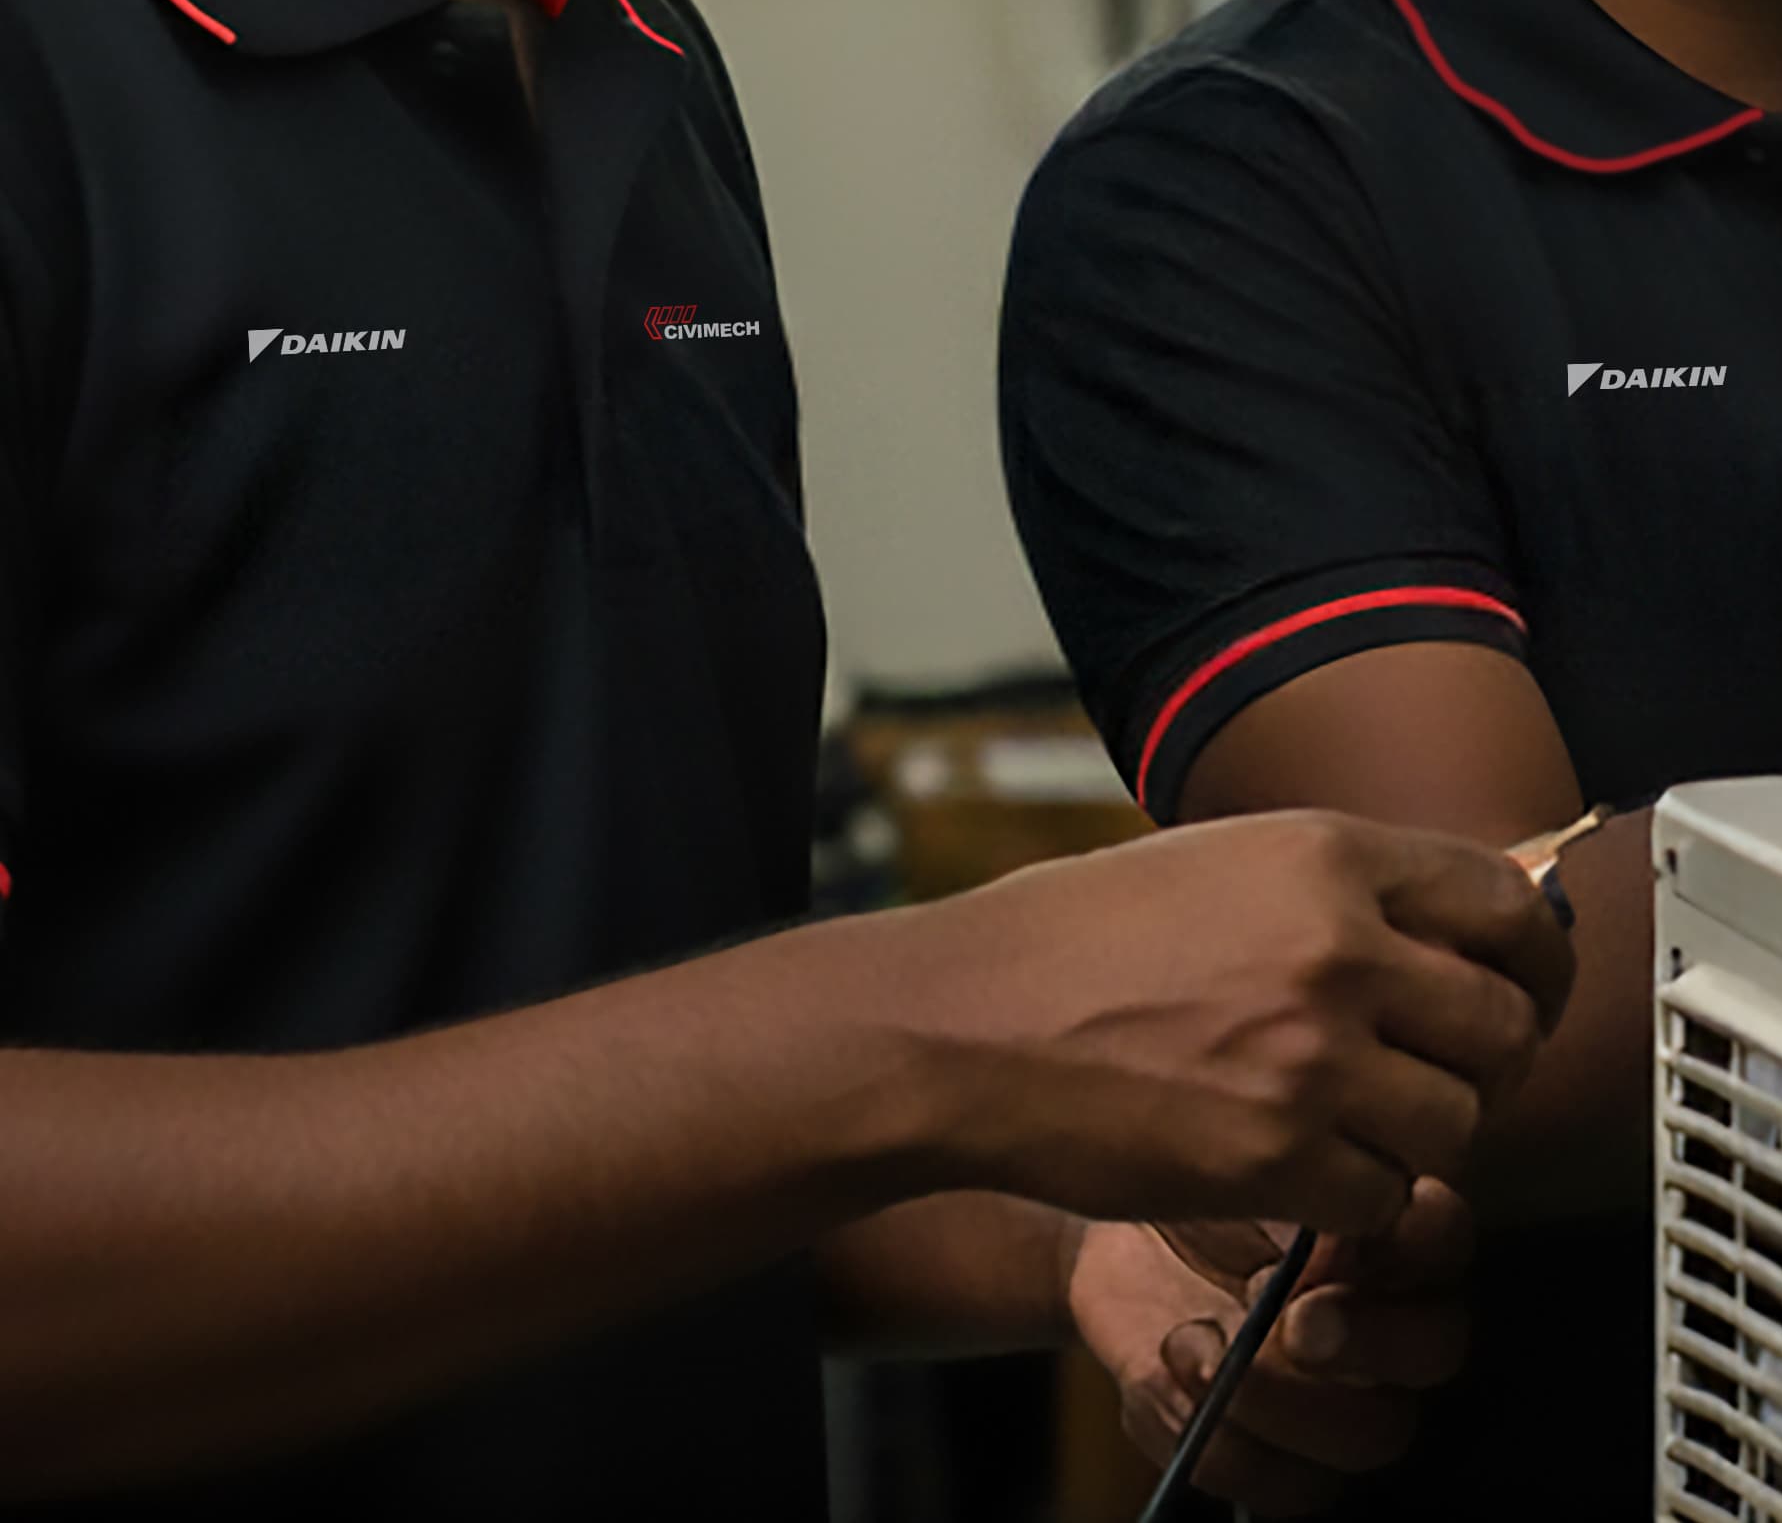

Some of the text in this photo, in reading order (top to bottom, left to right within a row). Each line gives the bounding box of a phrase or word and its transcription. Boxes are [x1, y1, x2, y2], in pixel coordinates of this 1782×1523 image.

[280, 328, 407, 356] DAIKIN
[663, 320, 760, 340] CIVIMECH
[1599, 365, 1728, 390] DAIKIN
